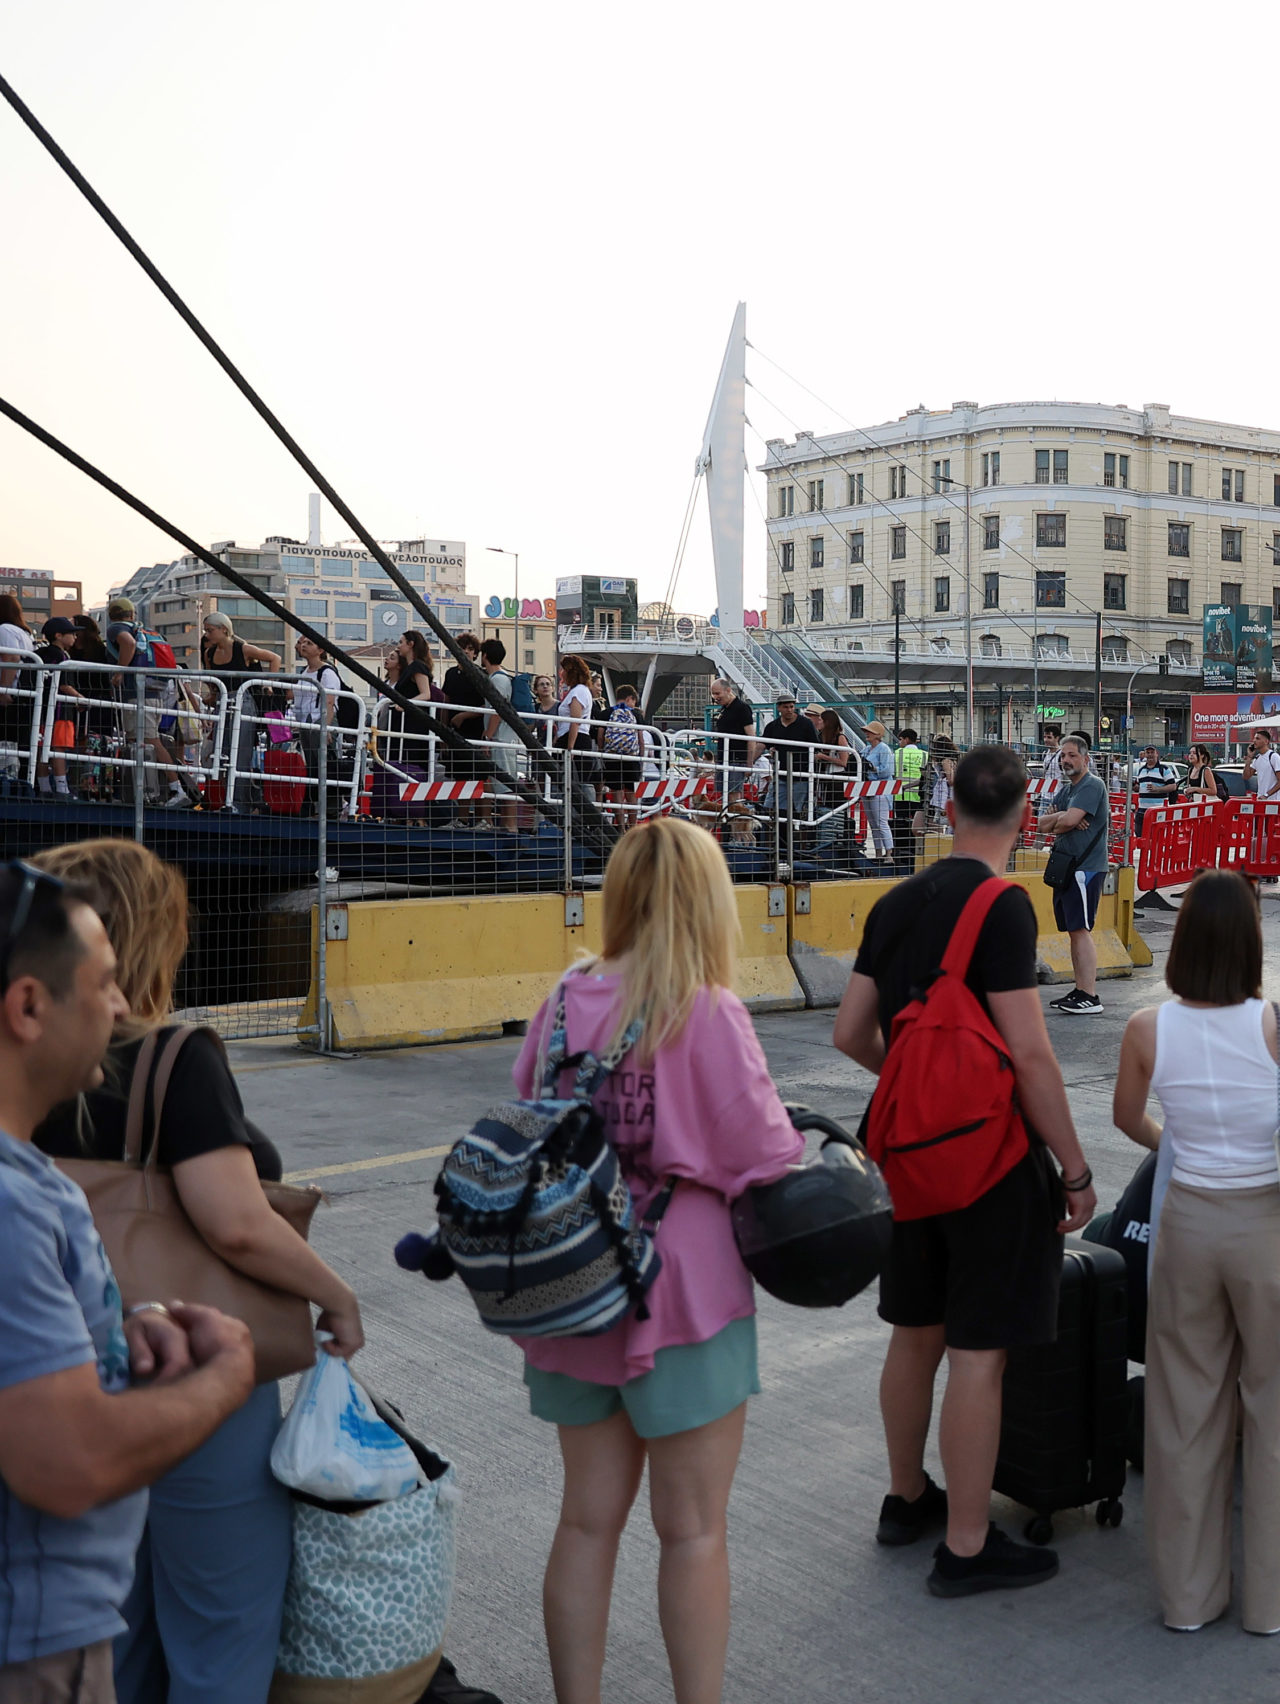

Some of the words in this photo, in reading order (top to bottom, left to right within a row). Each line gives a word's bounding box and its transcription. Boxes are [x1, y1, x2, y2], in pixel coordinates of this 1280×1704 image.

[280, 544, 368, 560] Γιαννοπουλος
[384, 553, 463, 567] γγελοπουλος
[484, 595, 556, 620] JUMB
[1208, 606, 1231, 616] novibet
[1241, 624, 1267, 633] novibet
[1194, 713, 1210, 722] One
[1210, 714, 1229, 722] more
[1229, 712, 1266, 722] adventure
